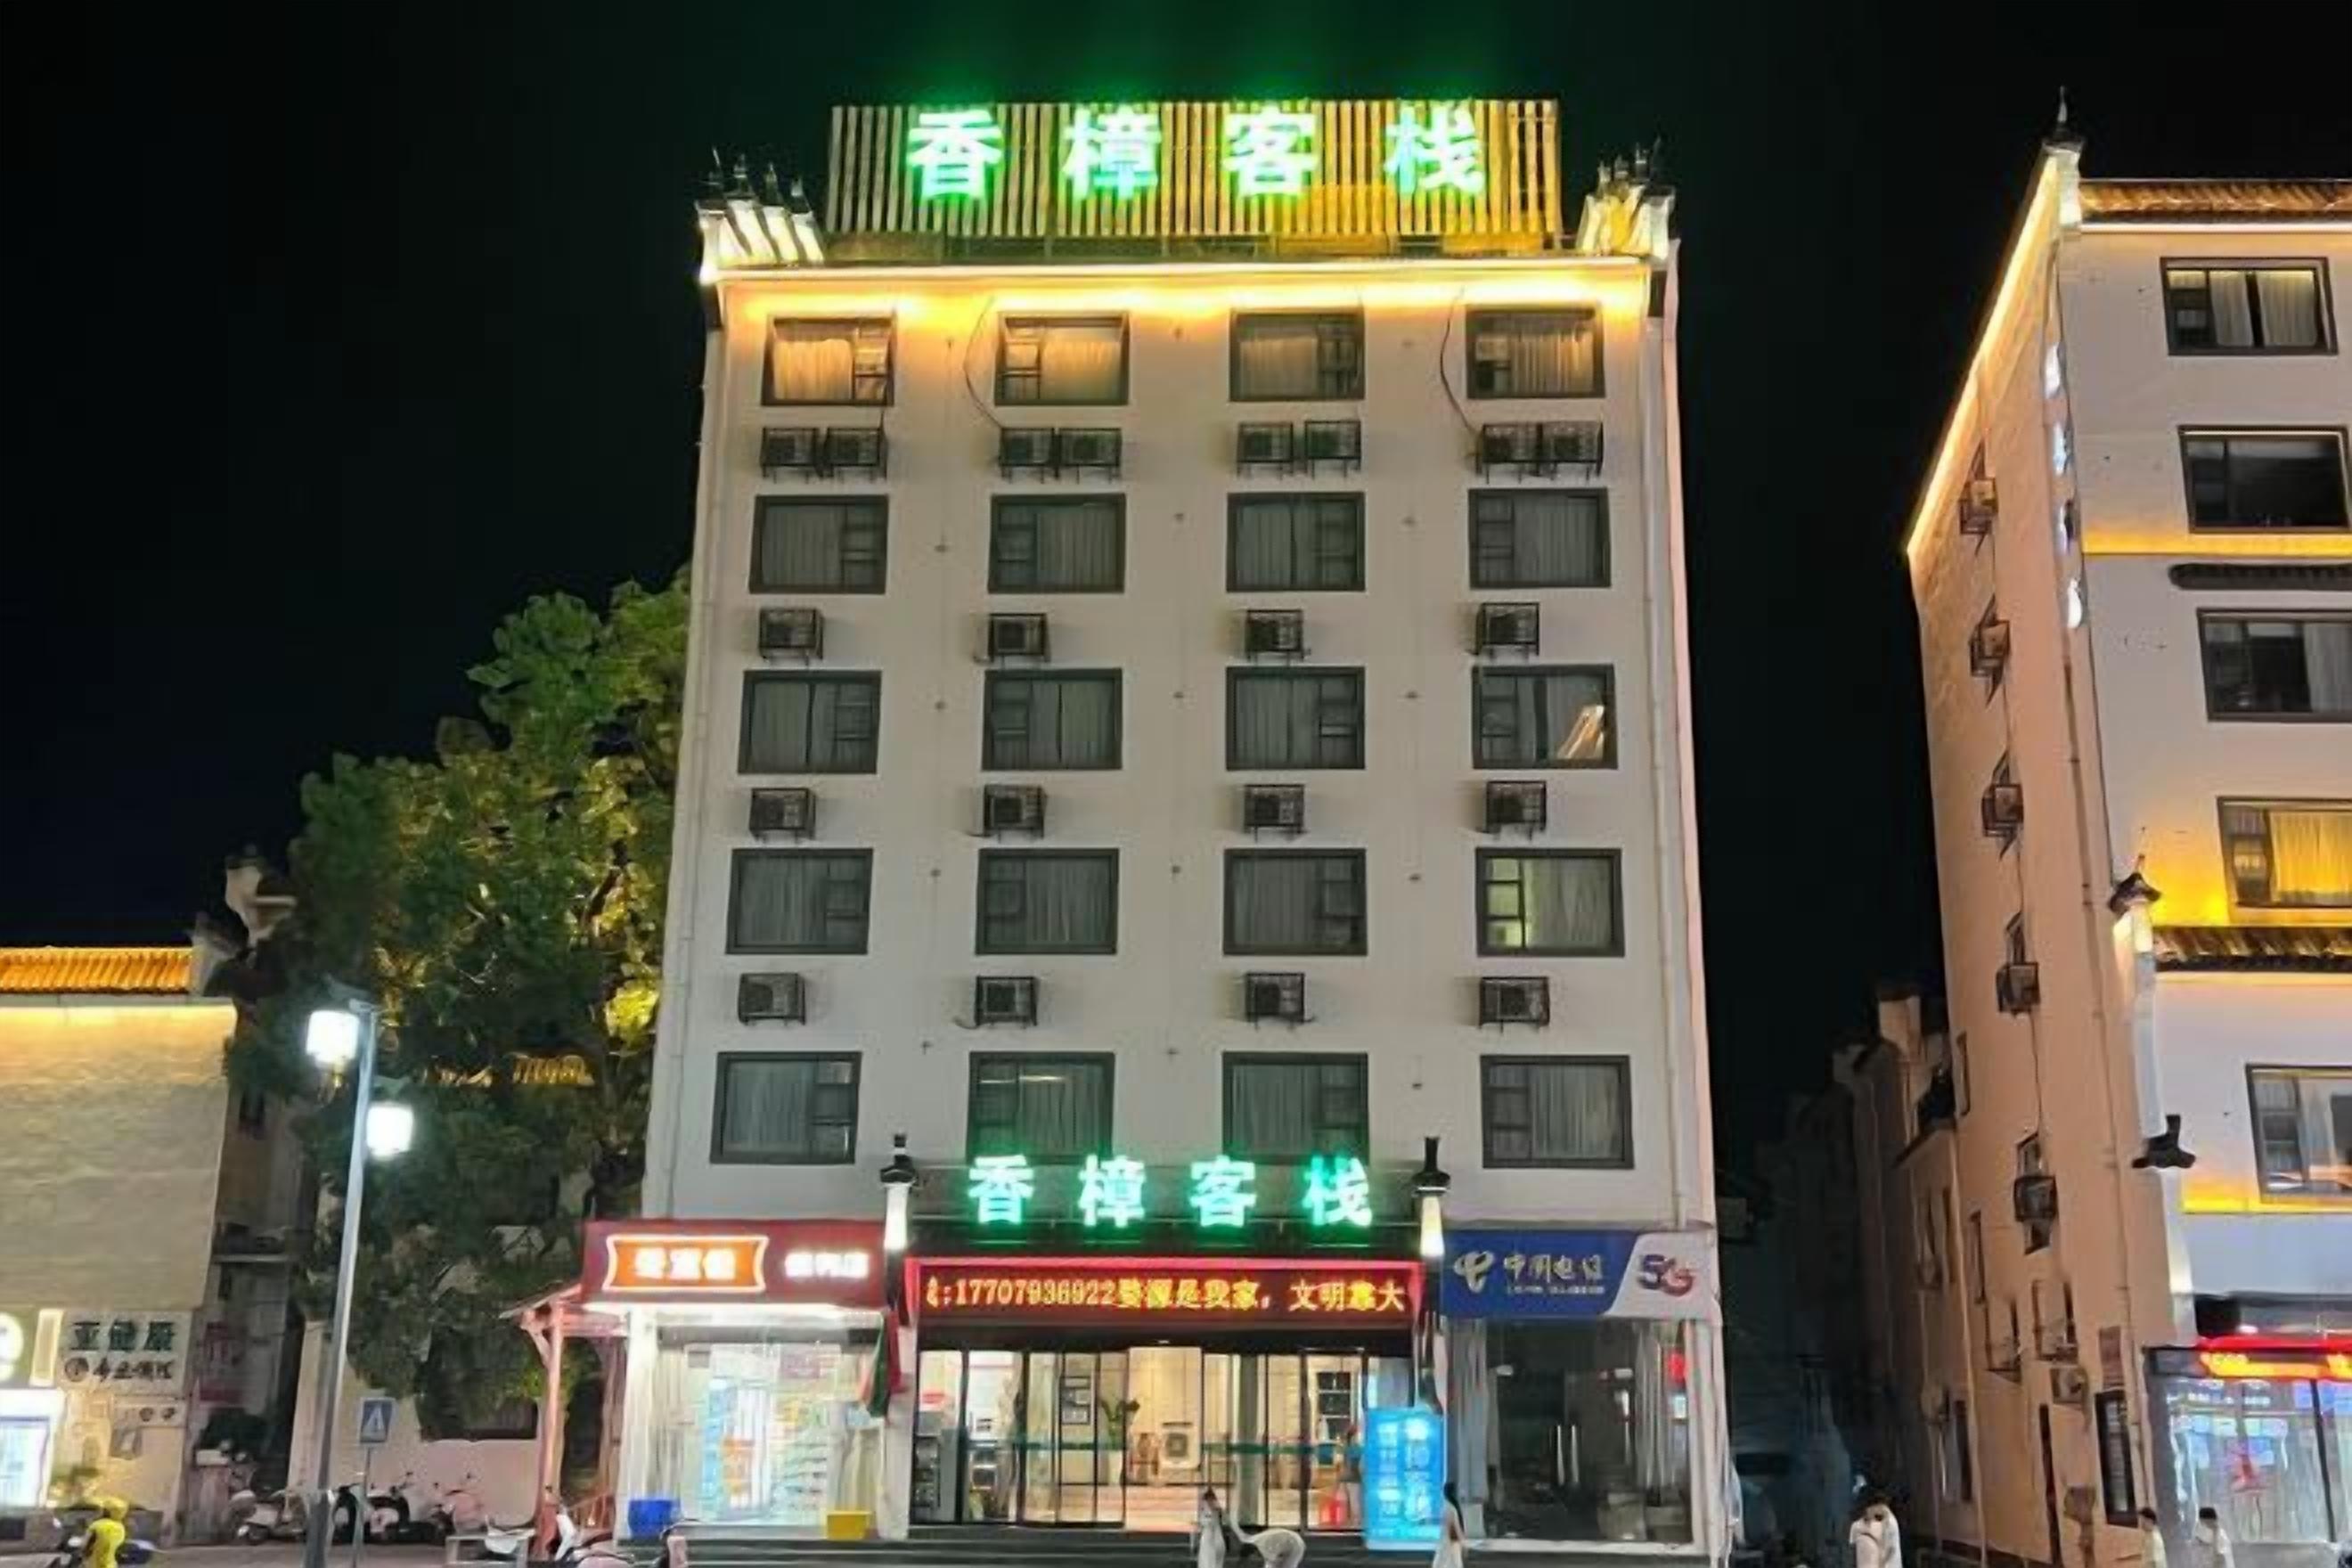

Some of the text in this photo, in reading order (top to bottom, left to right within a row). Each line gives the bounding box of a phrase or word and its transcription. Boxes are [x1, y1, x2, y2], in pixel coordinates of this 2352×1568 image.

[906, 106, 1486, 200] 香樟客栈
[968, 1155, 1372, 1226] 香樟客栈
[1637, 1254, 1696, 1297] 5G
[70, 1319, 174, 1352] 亚健康
